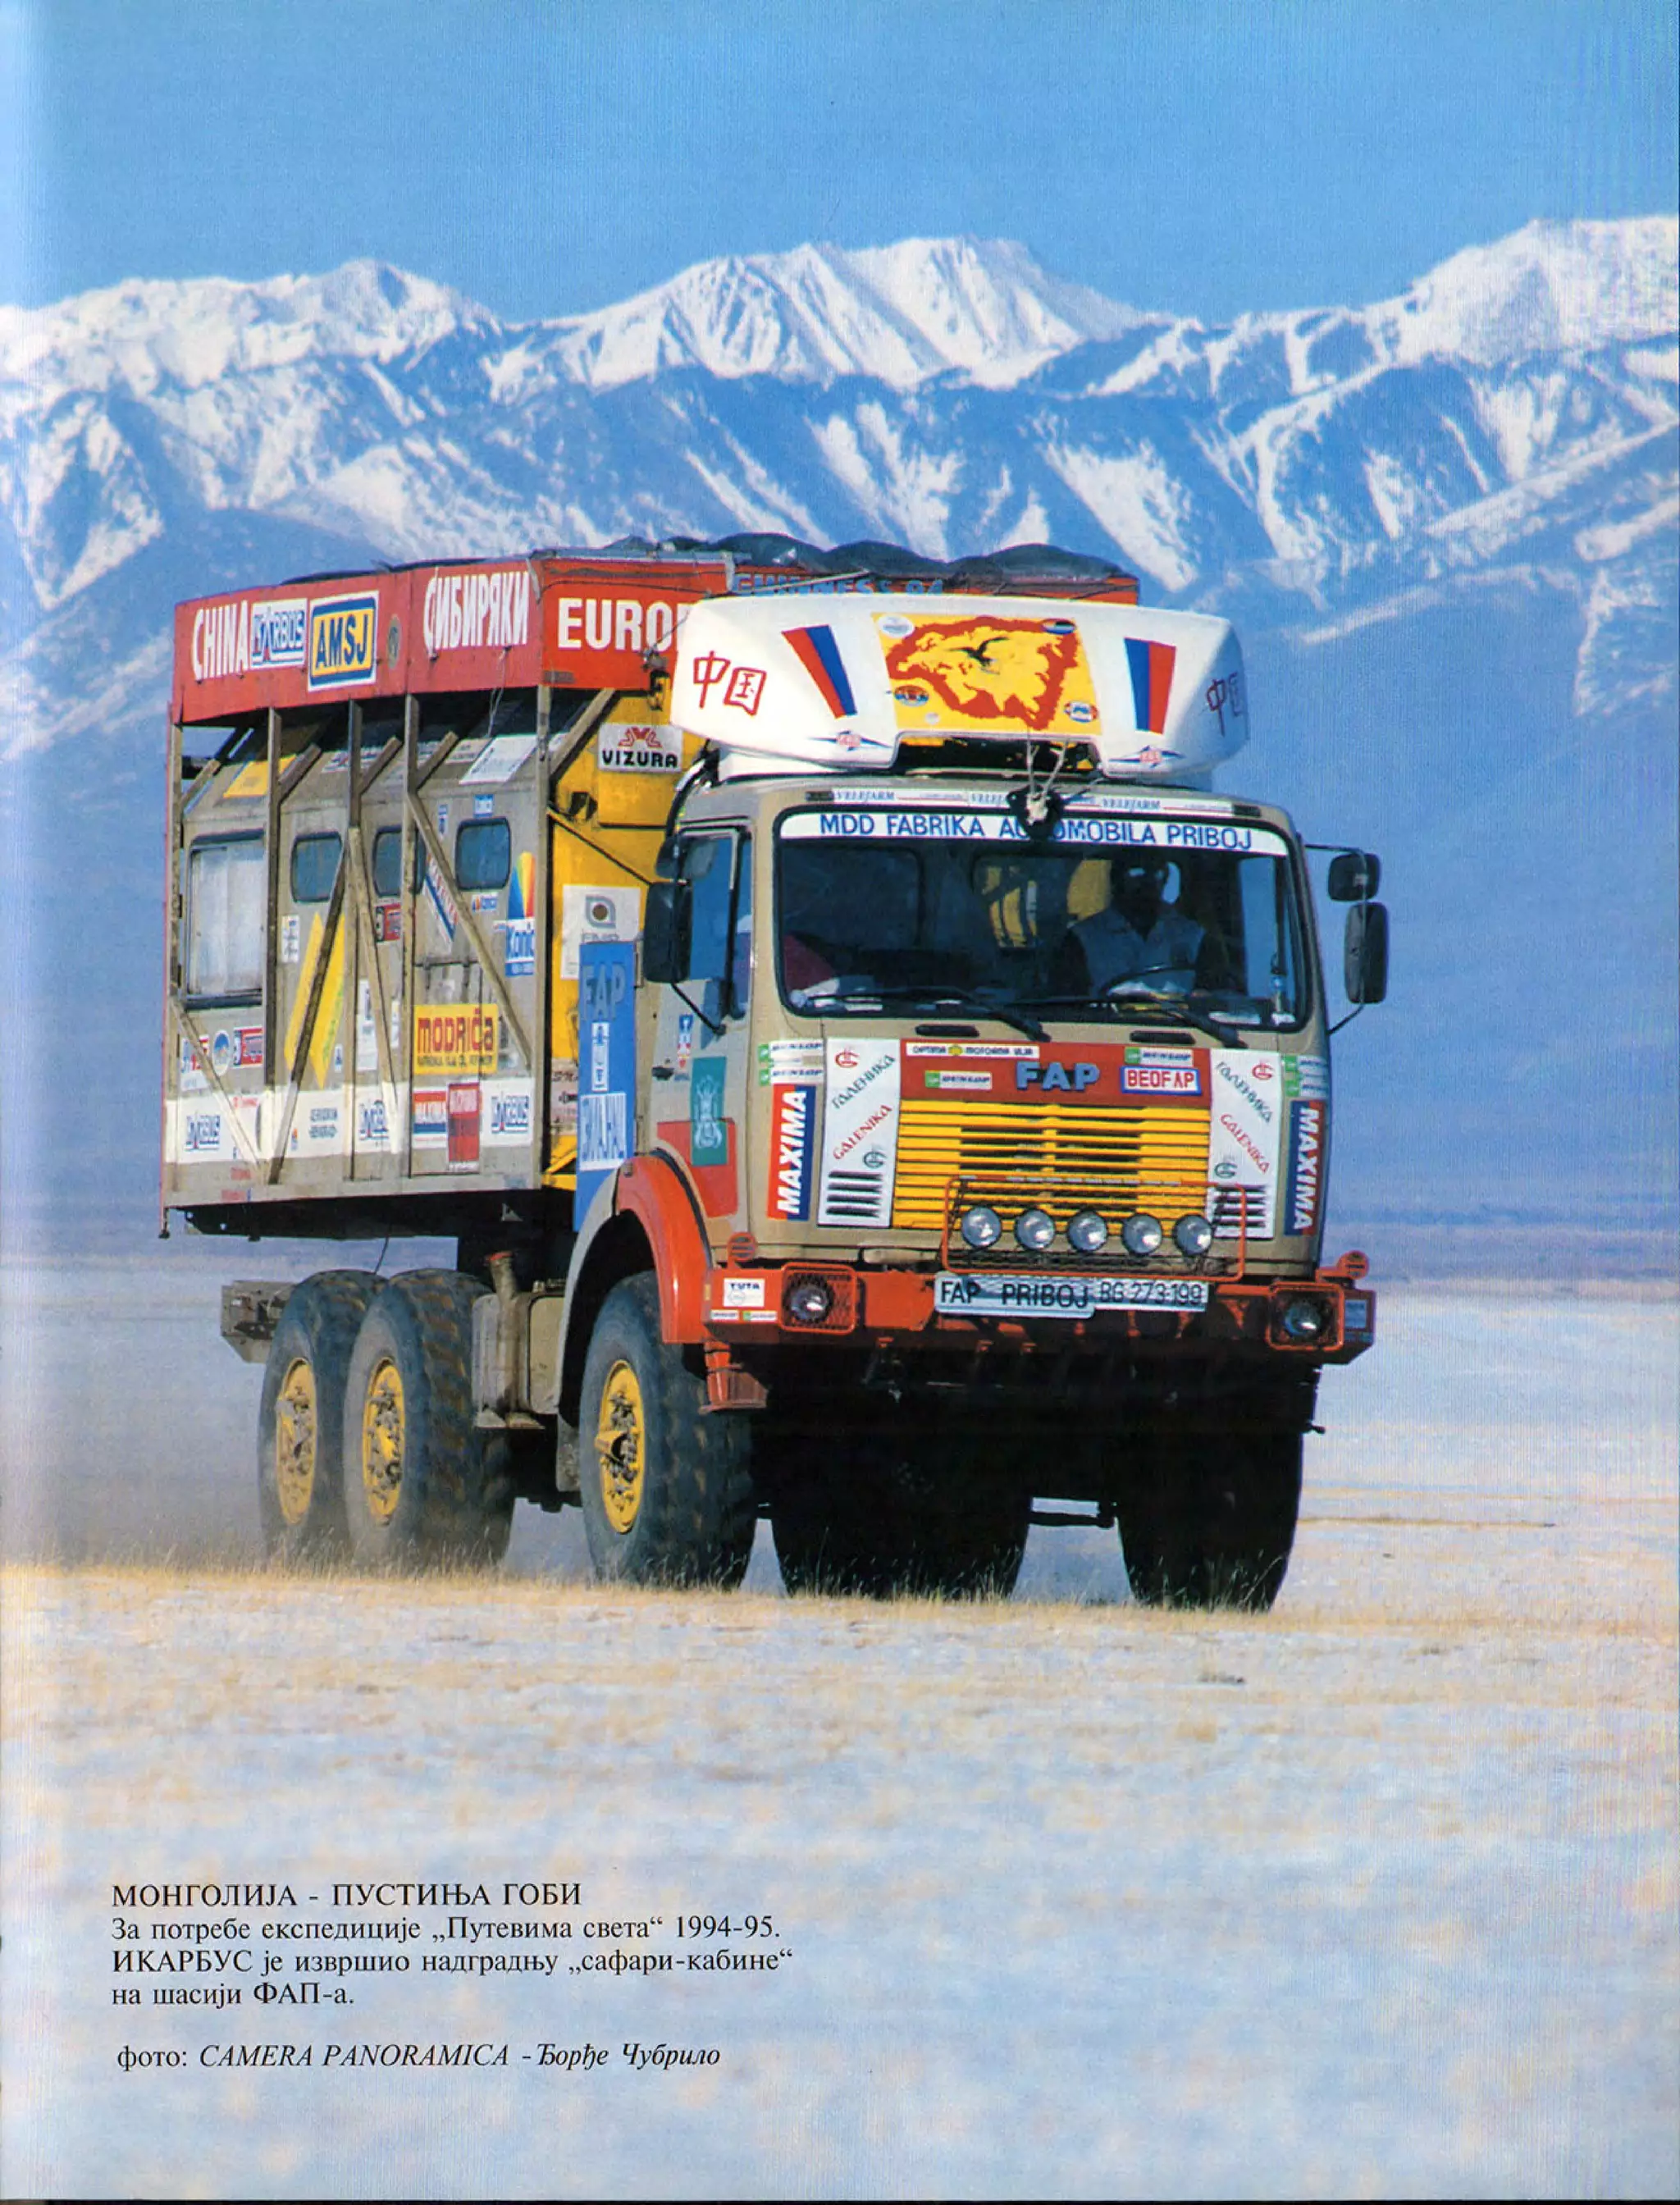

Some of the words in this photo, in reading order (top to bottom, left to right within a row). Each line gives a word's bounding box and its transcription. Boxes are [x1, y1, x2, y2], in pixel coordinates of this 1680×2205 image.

[423, 571, 530, 651] СИБИРЯКИ
[191, 600, 249, 681] CHINA
[315, 614, 369, 669] AMSJ
[693, 650, 768, 717] 中国
[601, 749, 678, 769] VIZURA
[819, 815, 875, 836] MDD
[887, 815, 985, 837] FABRIKA
[998, 816, 1157, 845] AUOMOBILA
[1166, 824, 1253, 851] PRIBOJ
[582, 961, 627, 1022] FAP
[1016, 1061, 1102, 1093] FAP
[1126, 1069, 1196, 1089] BEOFAP
[776, 1090, 807, 1216] MAXIMA
[1293, 1107, 1320, 1230] MAXIMA
[940, 1281, 982, 1304] FAP
[1001, 1282, 1089, 1309] PRIBOJ
